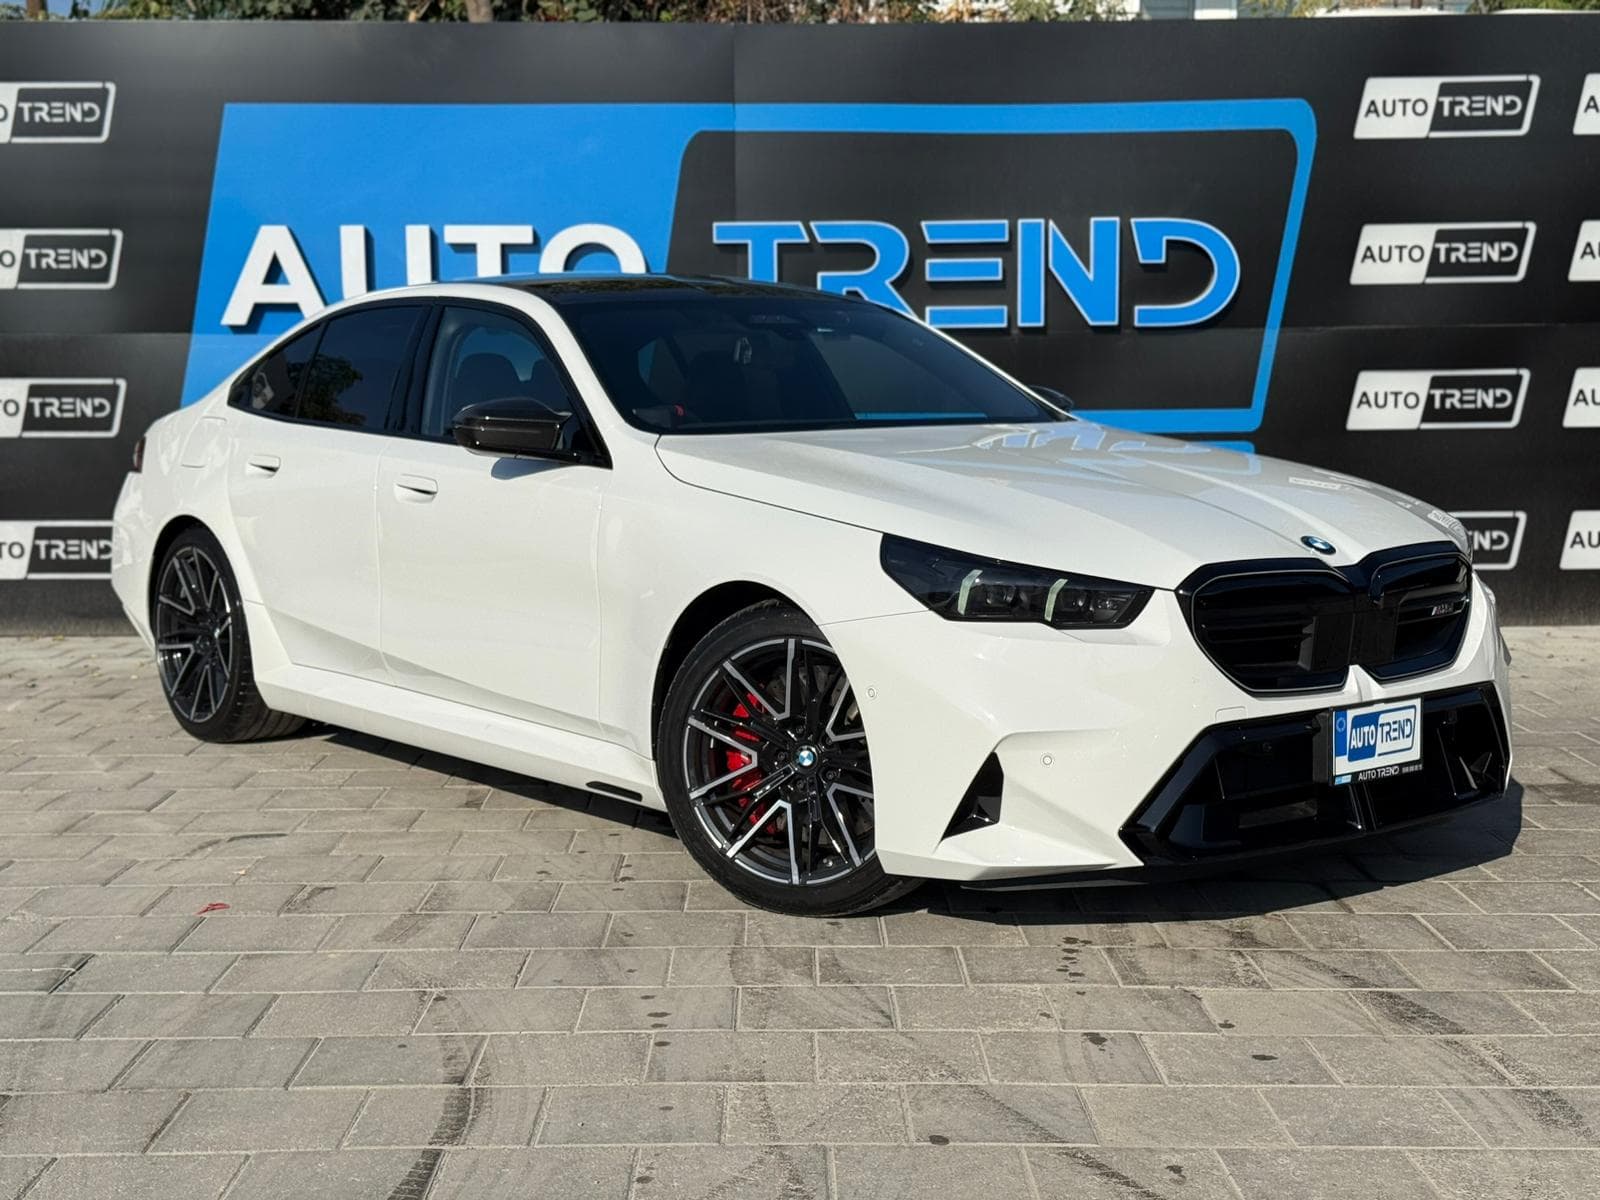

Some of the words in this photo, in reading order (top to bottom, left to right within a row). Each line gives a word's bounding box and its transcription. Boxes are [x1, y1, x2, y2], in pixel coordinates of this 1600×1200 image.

[18, 102, 100, 123] TREND
[1364, 98, 1429, 118] AUTO
[1438, 95, 1522, 117] TREND
[25, 248, 108, 269] TREND
[1360, 245, 1425, 264] AUTO
[1434, 242, 1518, 263] TREND
[713, 217, 1241, 328] TREND
[29, 397, 111, 418] TREND
[1356, 391, 1420, 410] AUTO
[1430, 388, 1513, 410] TREND
[34, 539, 113, 560] TREND
[1570, 531, 1600, 548] AU
[1350, 724, 1376, 750] AUTO
[1379, 718, 1413, 744] TREND
[1358, 769, 1377, 781] AUTO
[1377, 765, 1400, 777] TREND
